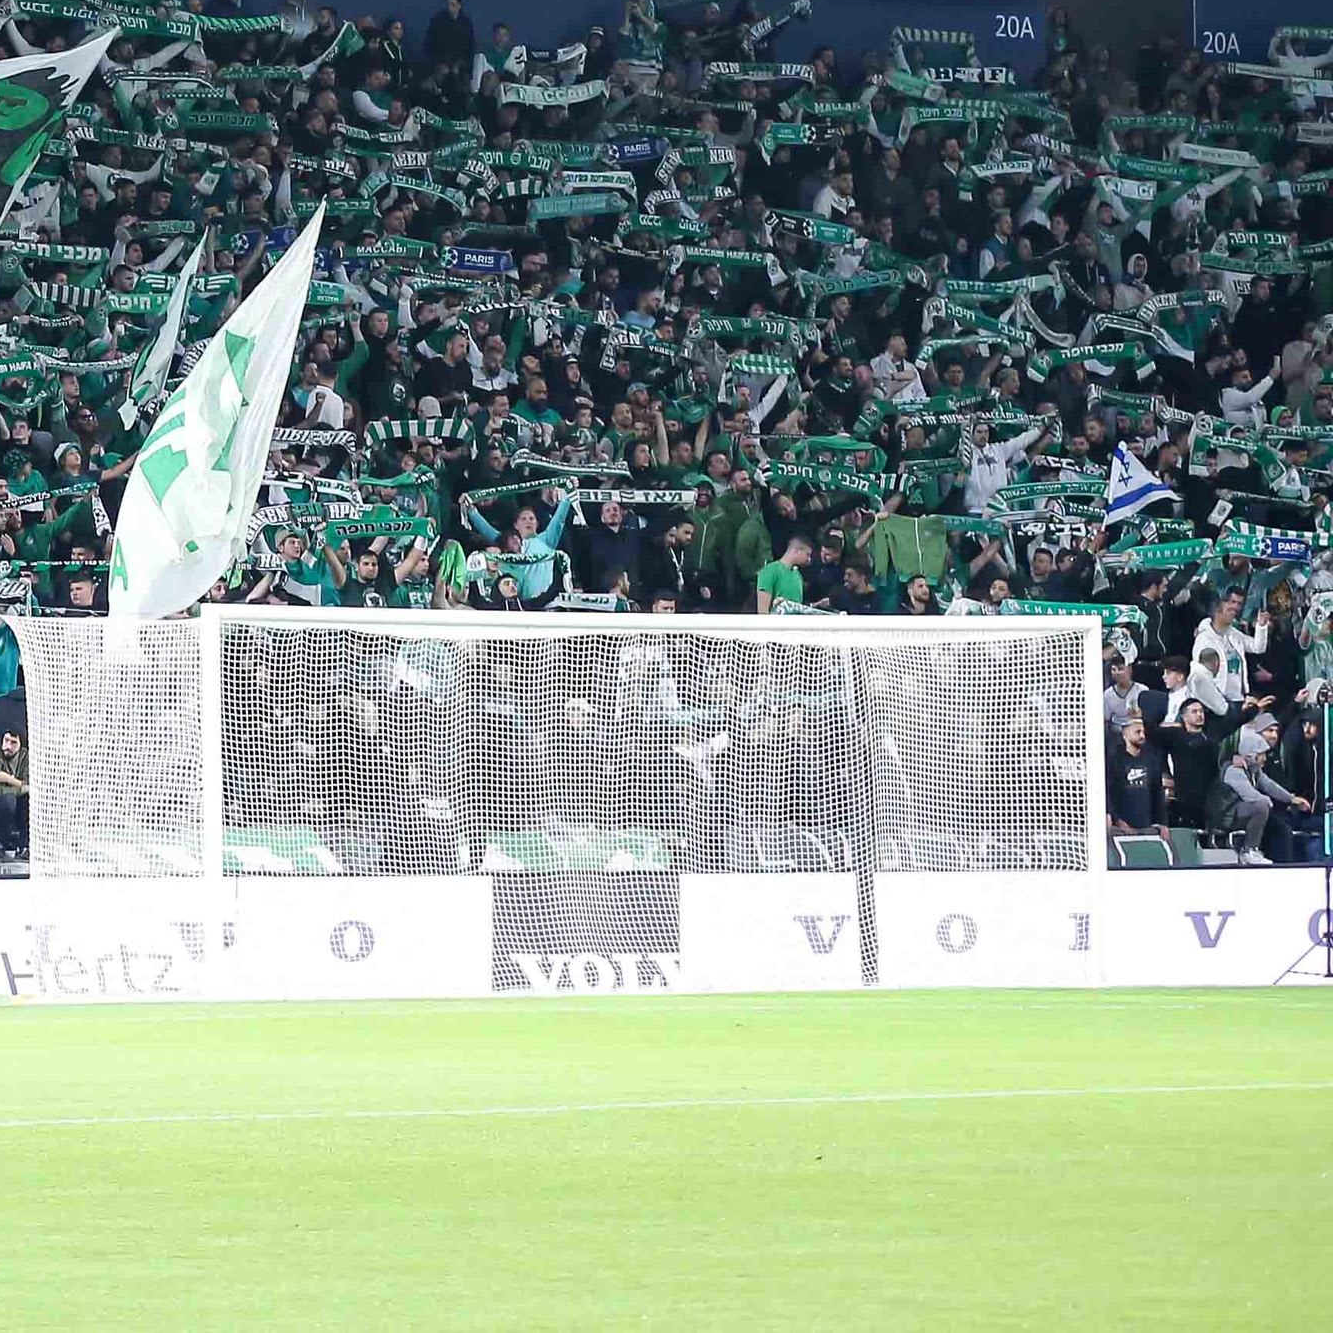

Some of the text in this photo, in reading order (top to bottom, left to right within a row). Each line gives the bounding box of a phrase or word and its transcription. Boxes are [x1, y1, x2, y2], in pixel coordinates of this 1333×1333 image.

[991, 15, 1034, 40] 20A
[1202, 30, 1241, 57] 20A
[623, 142, 650, 154] PARIS
[56, 245, 101, 261] מכבי
[463, 252, 494, 264] PARIS
[1060, 342, 1124, 359] מכבי חיפה
[776, 463, 869, 490] מכבי חיפה
[335, 520, 412, 537] מכבי חיפה
